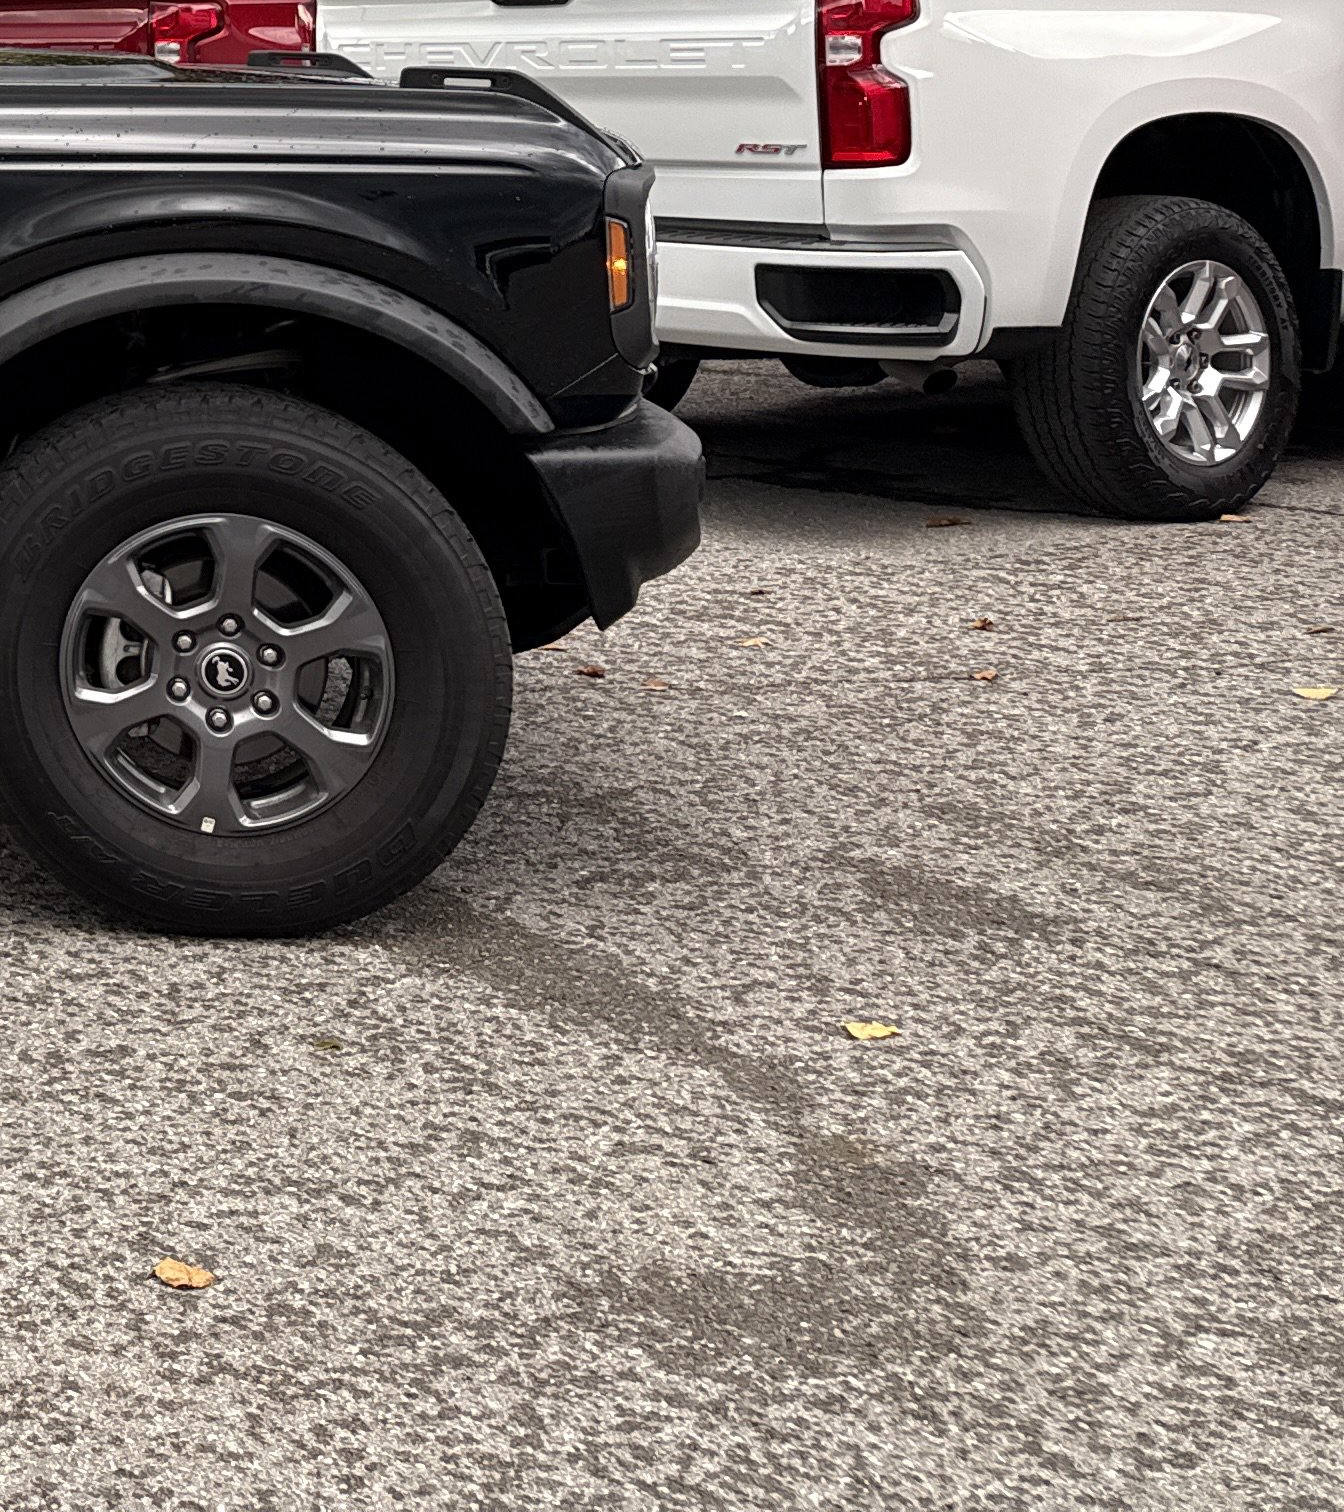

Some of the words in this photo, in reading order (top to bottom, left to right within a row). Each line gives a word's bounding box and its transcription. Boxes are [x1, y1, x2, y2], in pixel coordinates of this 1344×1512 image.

[335, 36, 767, 70] CHEVROLET
[734, 143, 808, 157] RST
[12, 438, 384, 580] BRIDGESTONE
